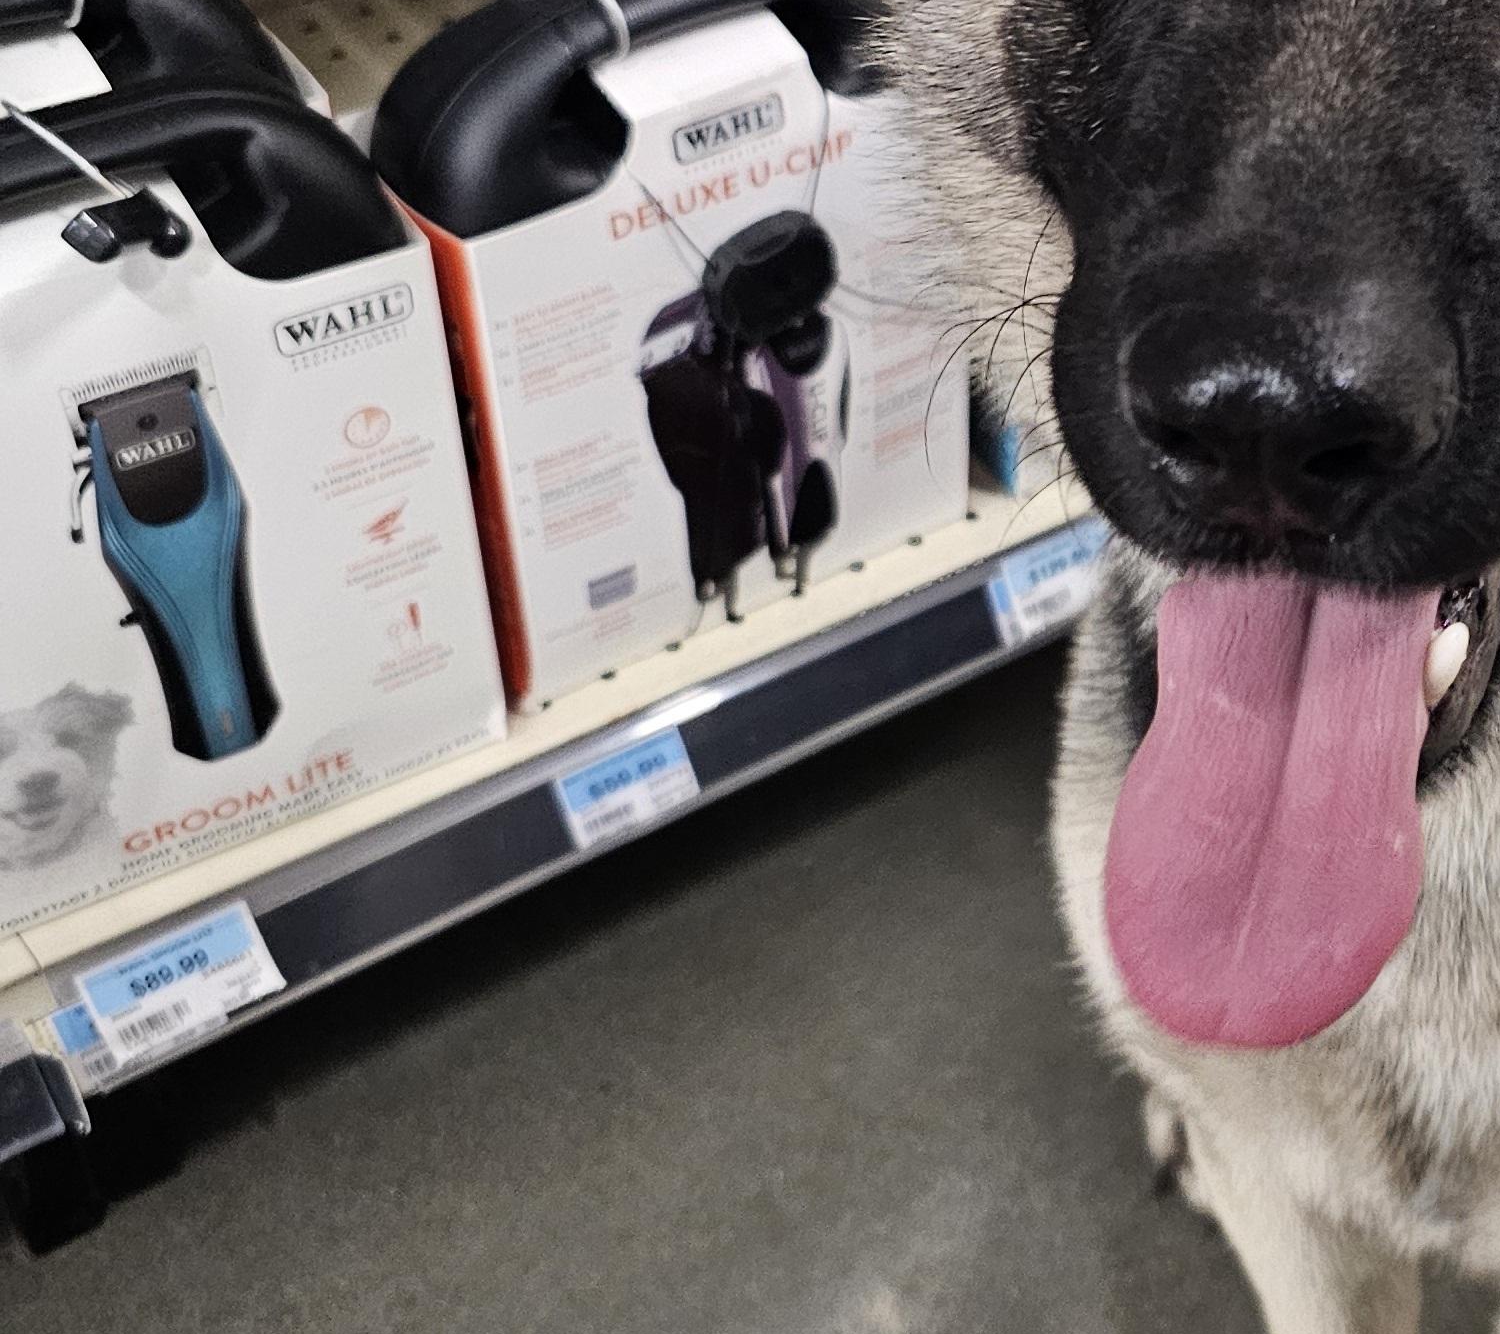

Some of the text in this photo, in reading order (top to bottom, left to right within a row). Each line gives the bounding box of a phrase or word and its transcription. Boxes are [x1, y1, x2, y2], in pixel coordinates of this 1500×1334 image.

[682, 103, 776, 152] WAHL
[608, 173, 741, 241] DELUXE
[748, 128, 853, 189] U-CLIP
[282, 292, 405, 347] WAHL
[118, 432, 193, 465] WAHL
[123, 747, 354, 854] GROOM LITE
[121, 846, 173, 871] HOME
